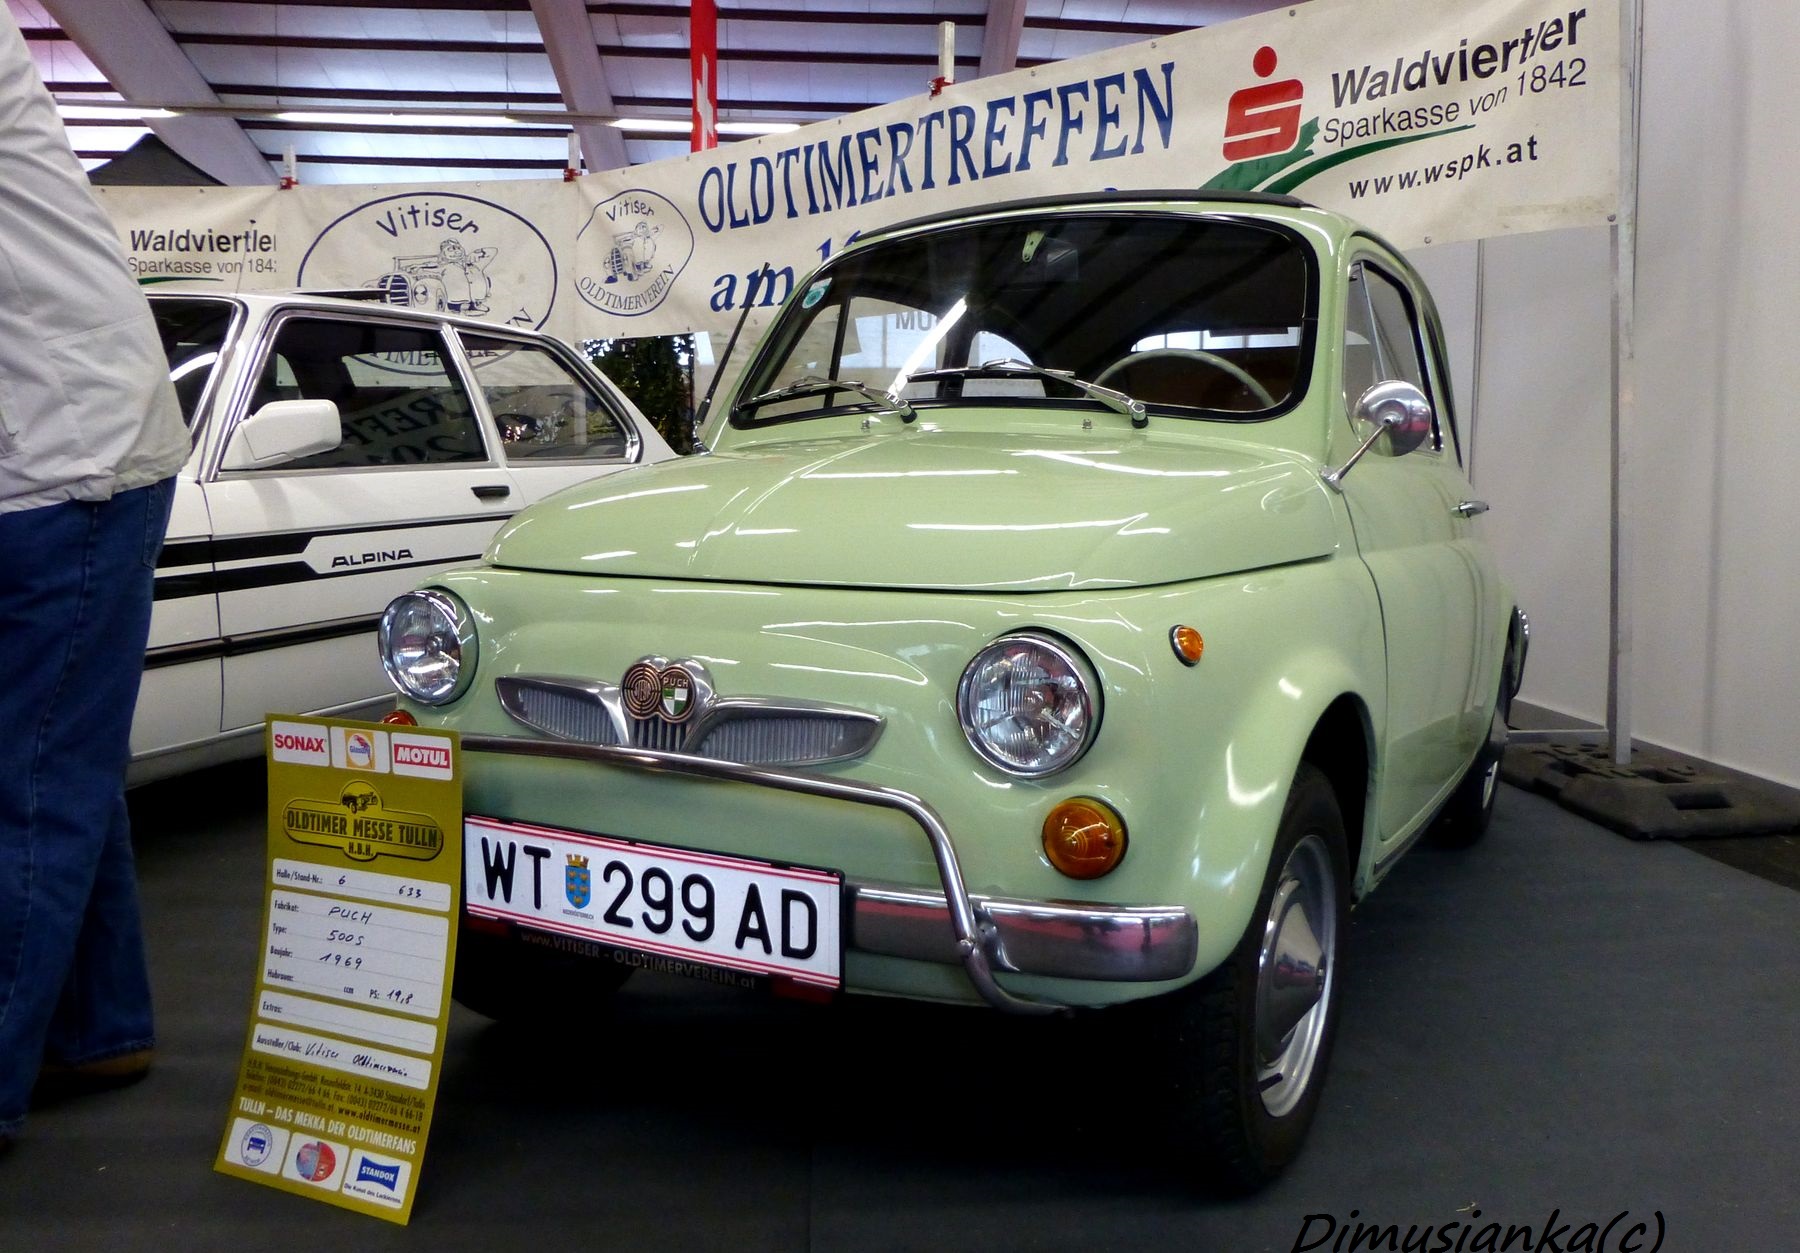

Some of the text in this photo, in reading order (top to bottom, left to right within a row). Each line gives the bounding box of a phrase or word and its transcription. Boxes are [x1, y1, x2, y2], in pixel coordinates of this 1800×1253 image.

[1331, 8, 1587, 109] Waldviertler
[1323, 57, 1587, 148] Sparkasse von 1842
[698, 61, 1176, 234] OLDTIMERTREFFEN
[1349, 134, 1539, 200] www.wspk.at
[376, 202, 479, 237] Vitiser
[605, 199, 655, 222] Vitiser
[127, 257, 277, 275] Sparkasse von 184
[580, 264, 676, 311] OLDTIMERVEREIN
[709, 265, 795, 313] am
[331, 548, 414, 569] ALPINA
[663, 677, 689, 687] PUCH
[274, 734, 326, 753] SONAX
[396, 745, 448, 767] MOTUL
[286, 810, 438, 848] OLDTIMER MESSE TULLN
[338, 875, 346, 885] 6
[398, 885, 422, 898] 633
[481, 836, 818, 960] WT 299 AD
[328, 906, 373, 924] PUCH
[319, 952, 363, 970] 1969
[386, 989, 414, 1005] 19,8
[239, 1096, 266, 1116] TULLN
[274, 1106, 293, 1122] DAS
[294, 1111, 326, 1131] MEKKA
[328, 1120, 346, 1136] DER
[348, 1124, 417, 1155] OLDTIMERFANS
[361, 1166, 395, 1182] STANDOX
